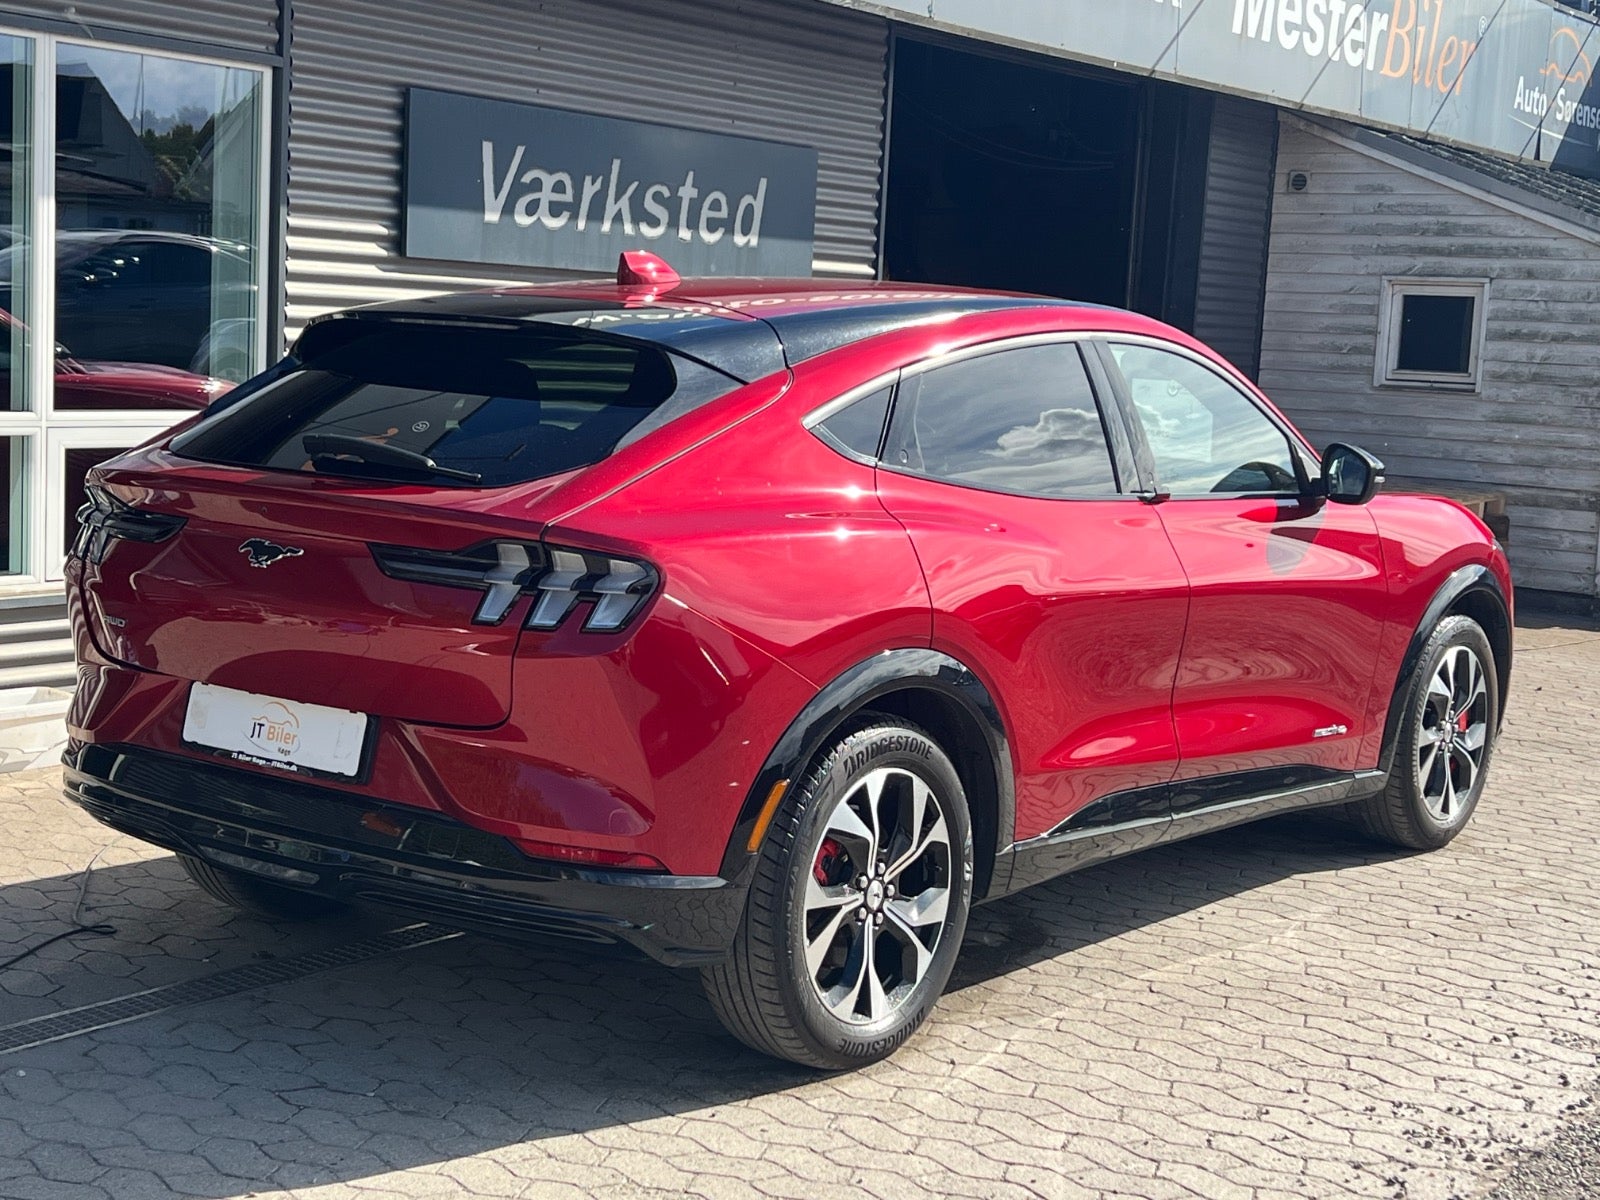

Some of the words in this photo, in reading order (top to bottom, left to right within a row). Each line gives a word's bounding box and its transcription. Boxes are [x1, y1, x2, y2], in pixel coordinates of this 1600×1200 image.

[1513, 75, 1547, 117] Auto
[481, 140, 768, 248] Værksted
[250, 722, 265, 738] JT
[267, 725, 297, 745] Biler
[843, 735, 934, 778] BRIDGESTONE
